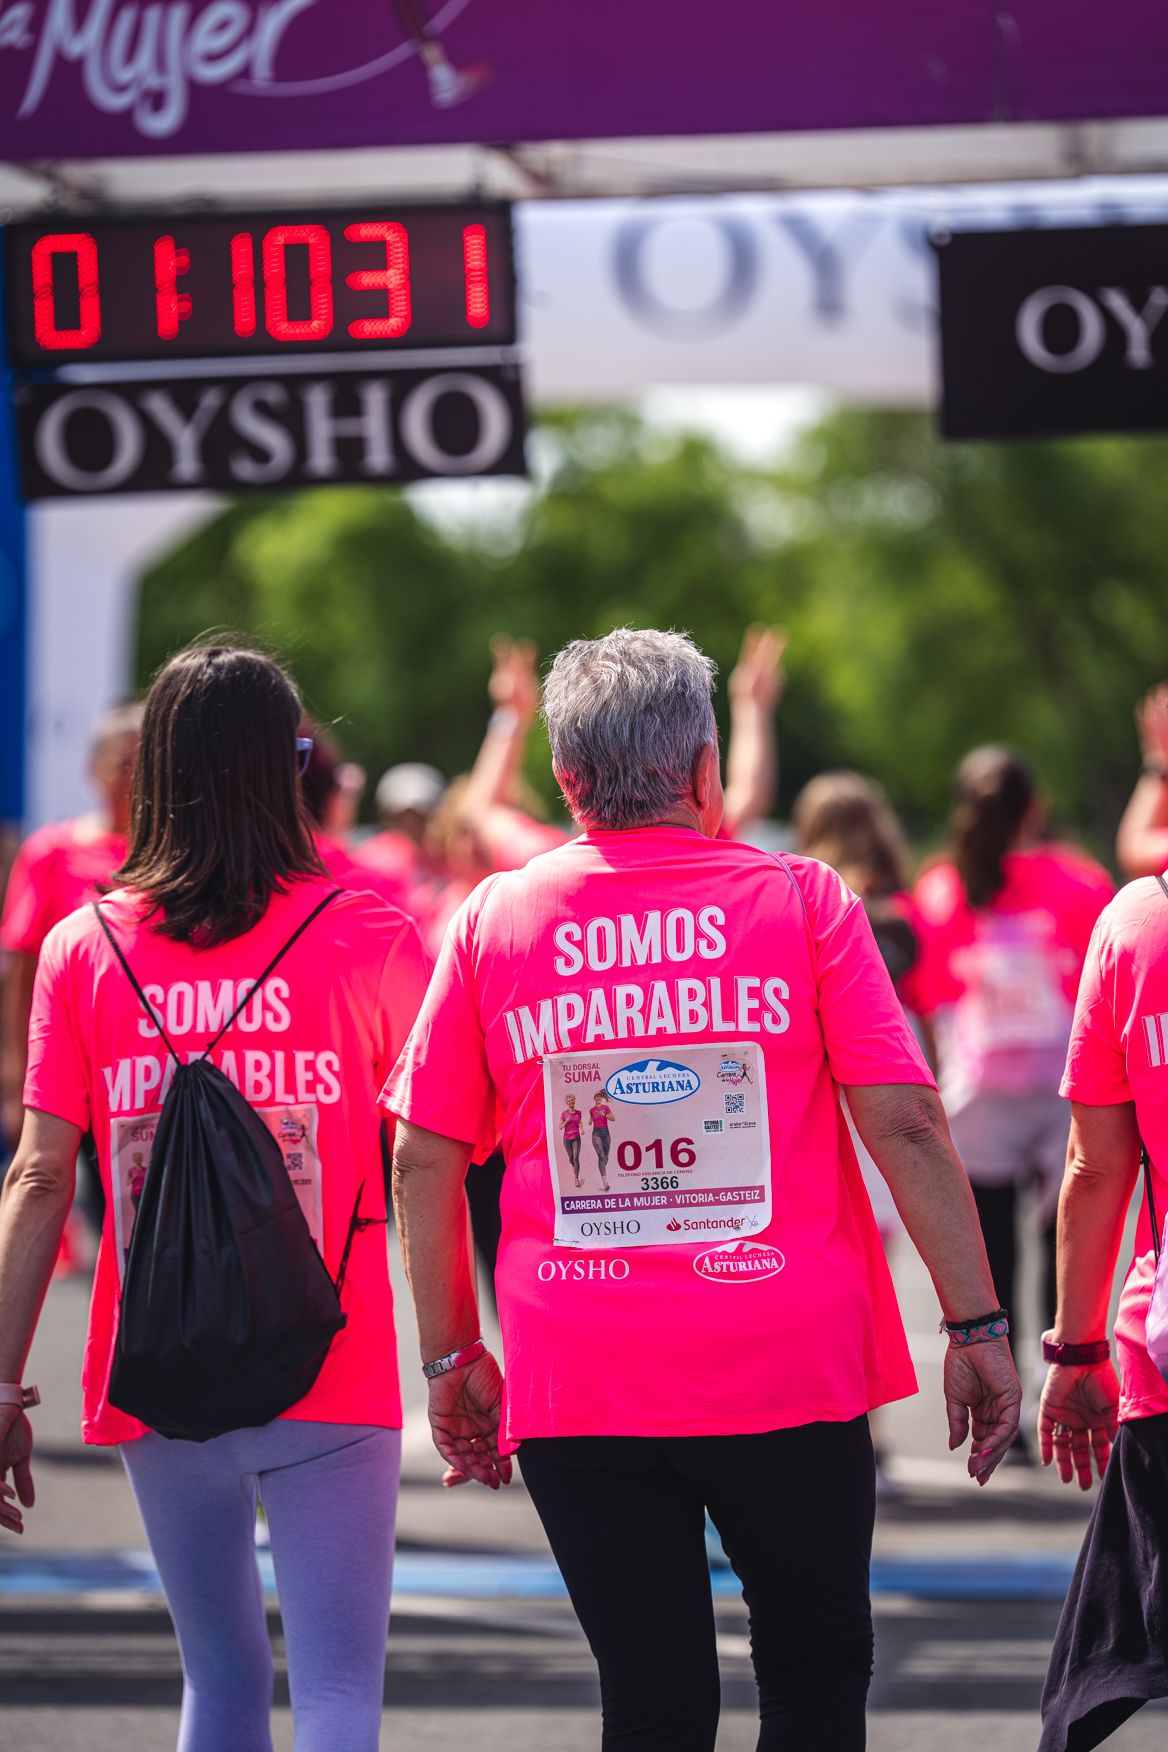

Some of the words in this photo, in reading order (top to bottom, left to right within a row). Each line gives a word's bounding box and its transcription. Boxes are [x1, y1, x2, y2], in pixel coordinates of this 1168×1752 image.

[36, 373, 512, 491] OYSHO
[553, 905, 726, 976] SOMOS
[137, 977, 291, 1038] SOMOS
[503, 976, 790, 1064] IMPARABLES
[562, 1064, 571, 1072] TU
[573, 1063, 600, 1071] DORSAL
[564, 1070, 602, 1083] SUMA
[613, 1078, 694, 1095] ASTURIANA
[617, 1137, 697, 1171] 016
[641, 1175, 679, 1191] 3366
[564, 1199, 602, 1211] CARRERA
[604, 1198, 616, 1208] DE
[619, 1197, 631, 1208] LA
[633, 1195, 668, 1206] MUJER
[580, 1219, 641, 1237] OYSHO
[683, 1217, 745, 1231] Santander
[537, 1259, 630, 1282] OYSHO
[701, 1255, 779, 1273] ASTURIANA
